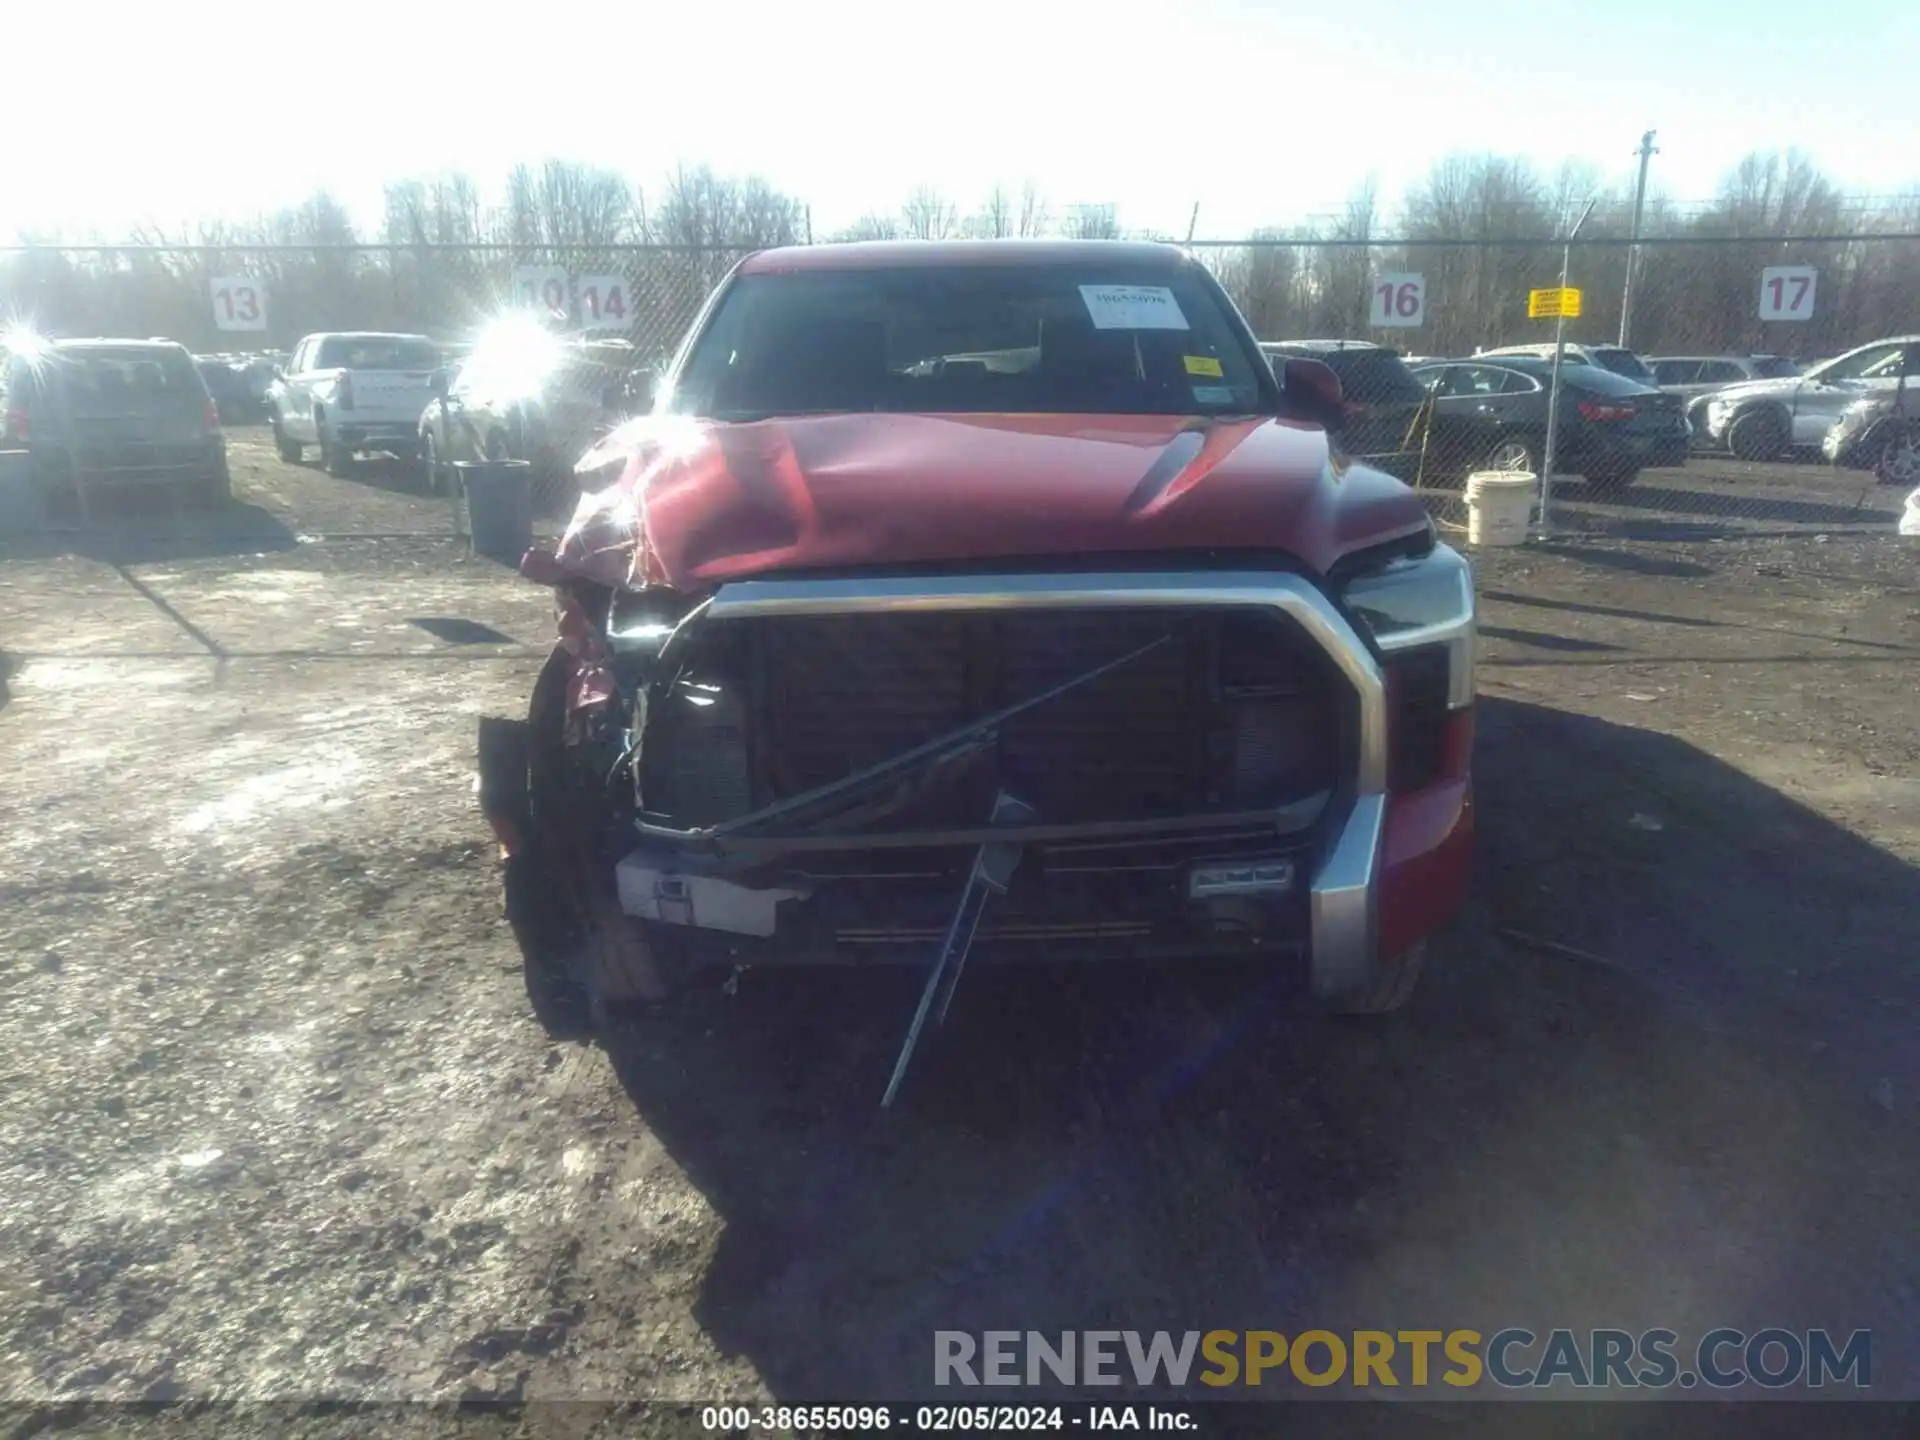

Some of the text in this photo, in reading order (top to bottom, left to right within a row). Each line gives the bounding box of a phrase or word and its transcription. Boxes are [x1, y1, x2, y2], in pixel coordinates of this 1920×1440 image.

[215, 286, 260, 321] 13
[583, 285, 626, 320] 14
[1377, 282, 1420, 317] 16
[1767, 276, 1810, 311] 17
